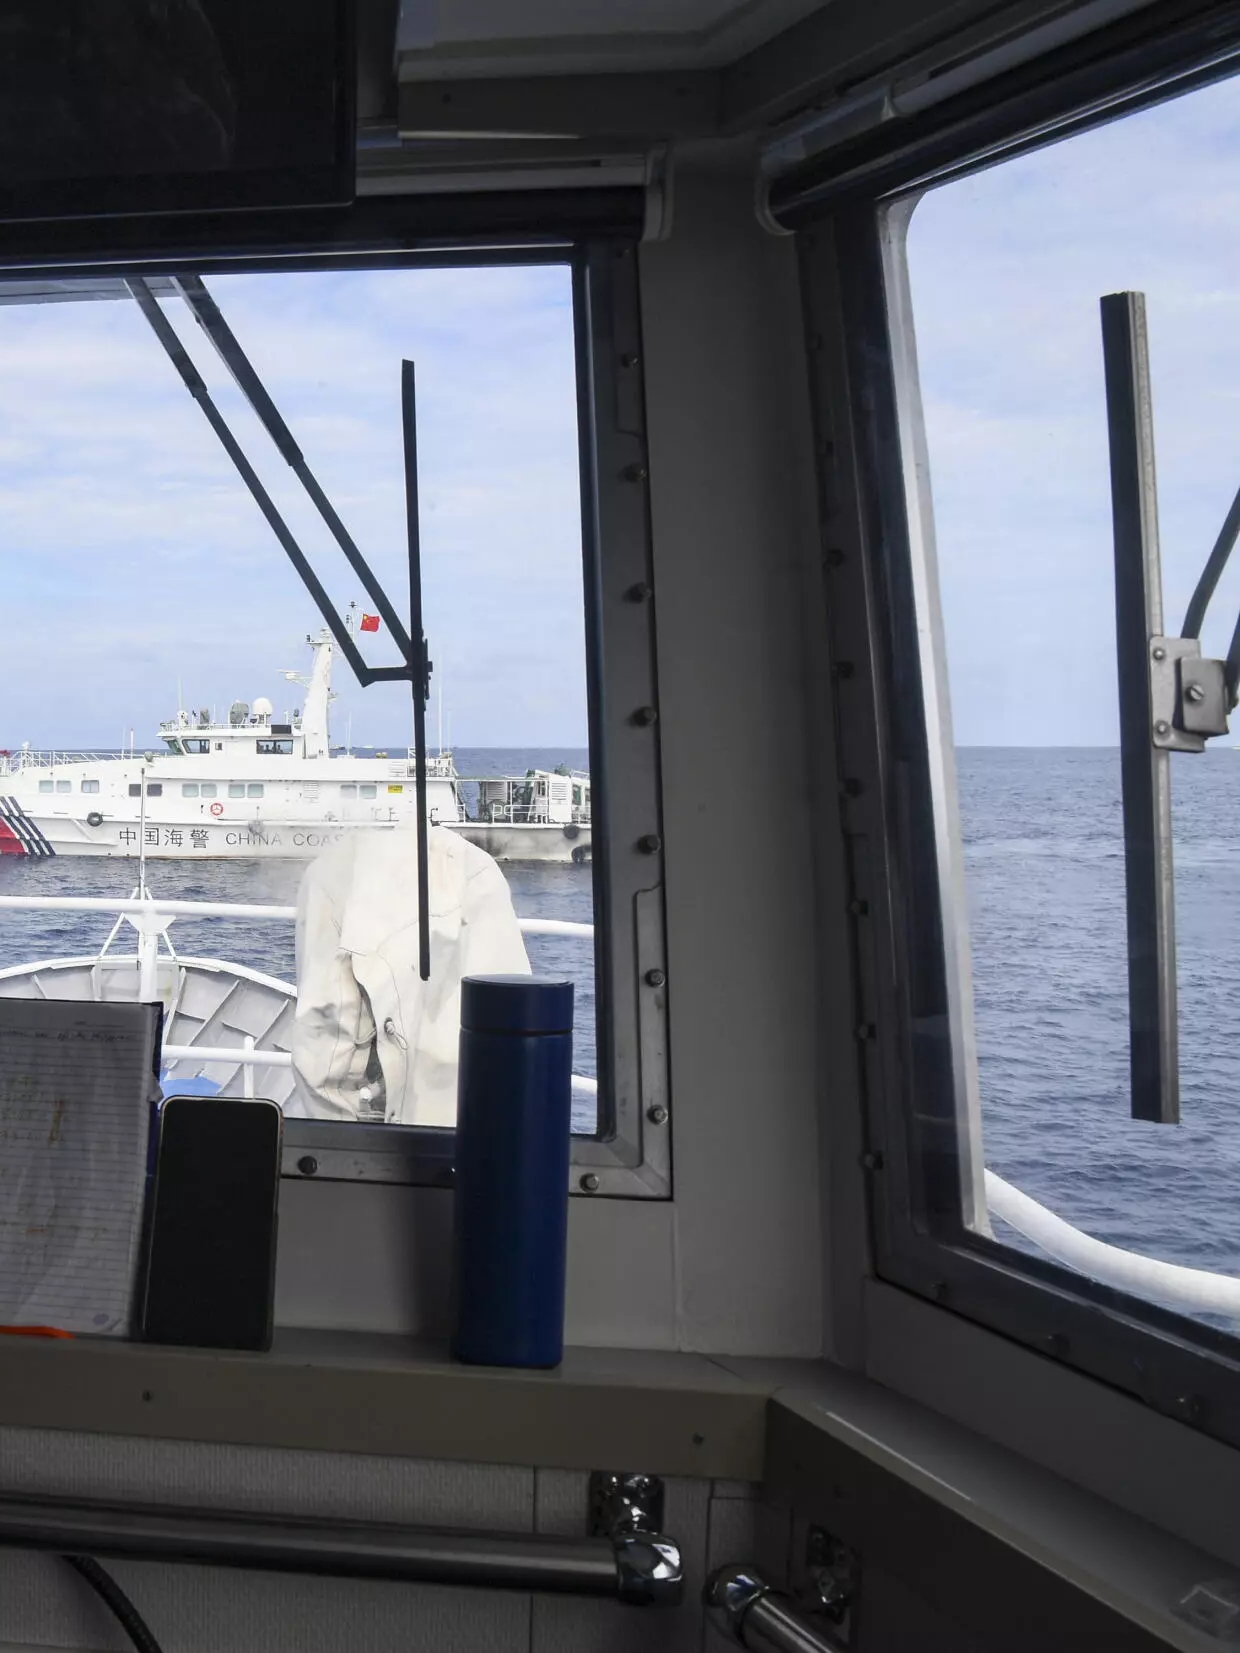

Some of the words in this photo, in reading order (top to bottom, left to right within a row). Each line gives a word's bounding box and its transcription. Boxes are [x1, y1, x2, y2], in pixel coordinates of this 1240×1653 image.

[119, 827, 210, 849] 中国海警
[225, 831, 283, 847] CHINA
